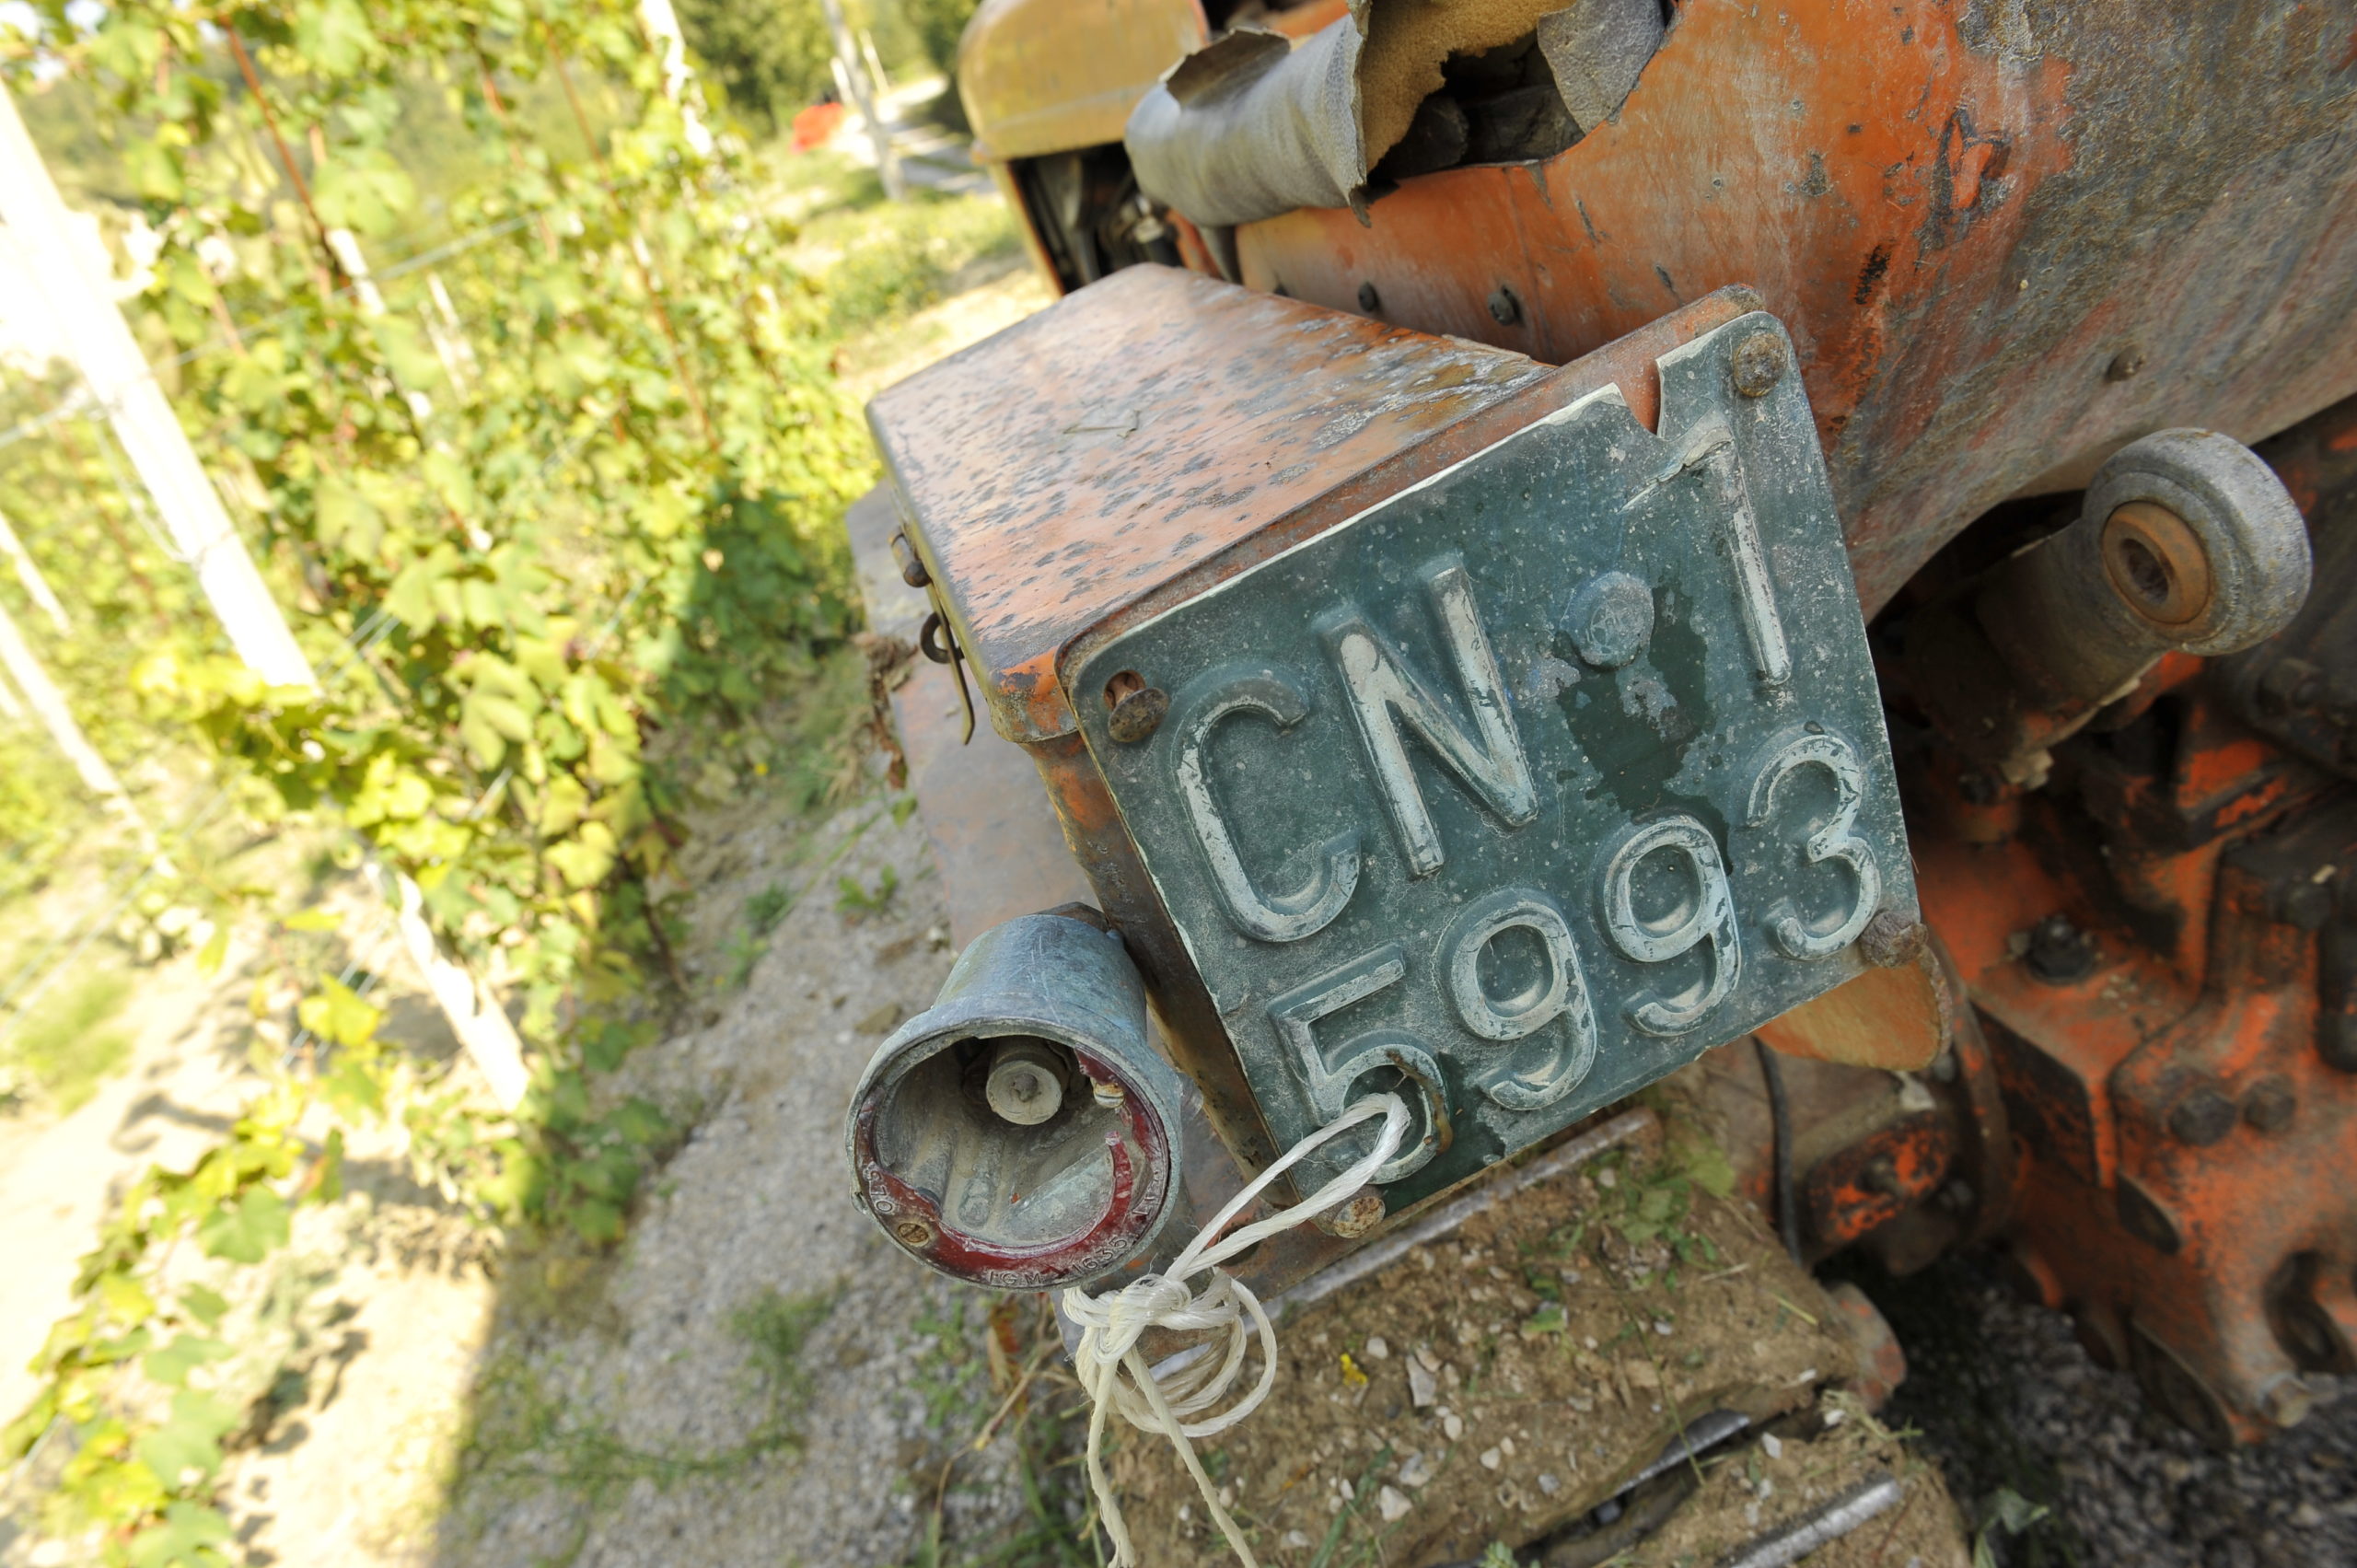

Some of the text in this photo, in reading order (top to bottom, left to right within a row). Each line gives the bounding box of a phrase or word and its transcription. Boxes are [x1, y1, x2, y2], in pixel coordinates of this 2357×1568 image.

[1167, 555, 1539, 943] CN
[1270, 732, 1883, 1185] 5993
[1071, 1238, 1128, 1275] 1635
